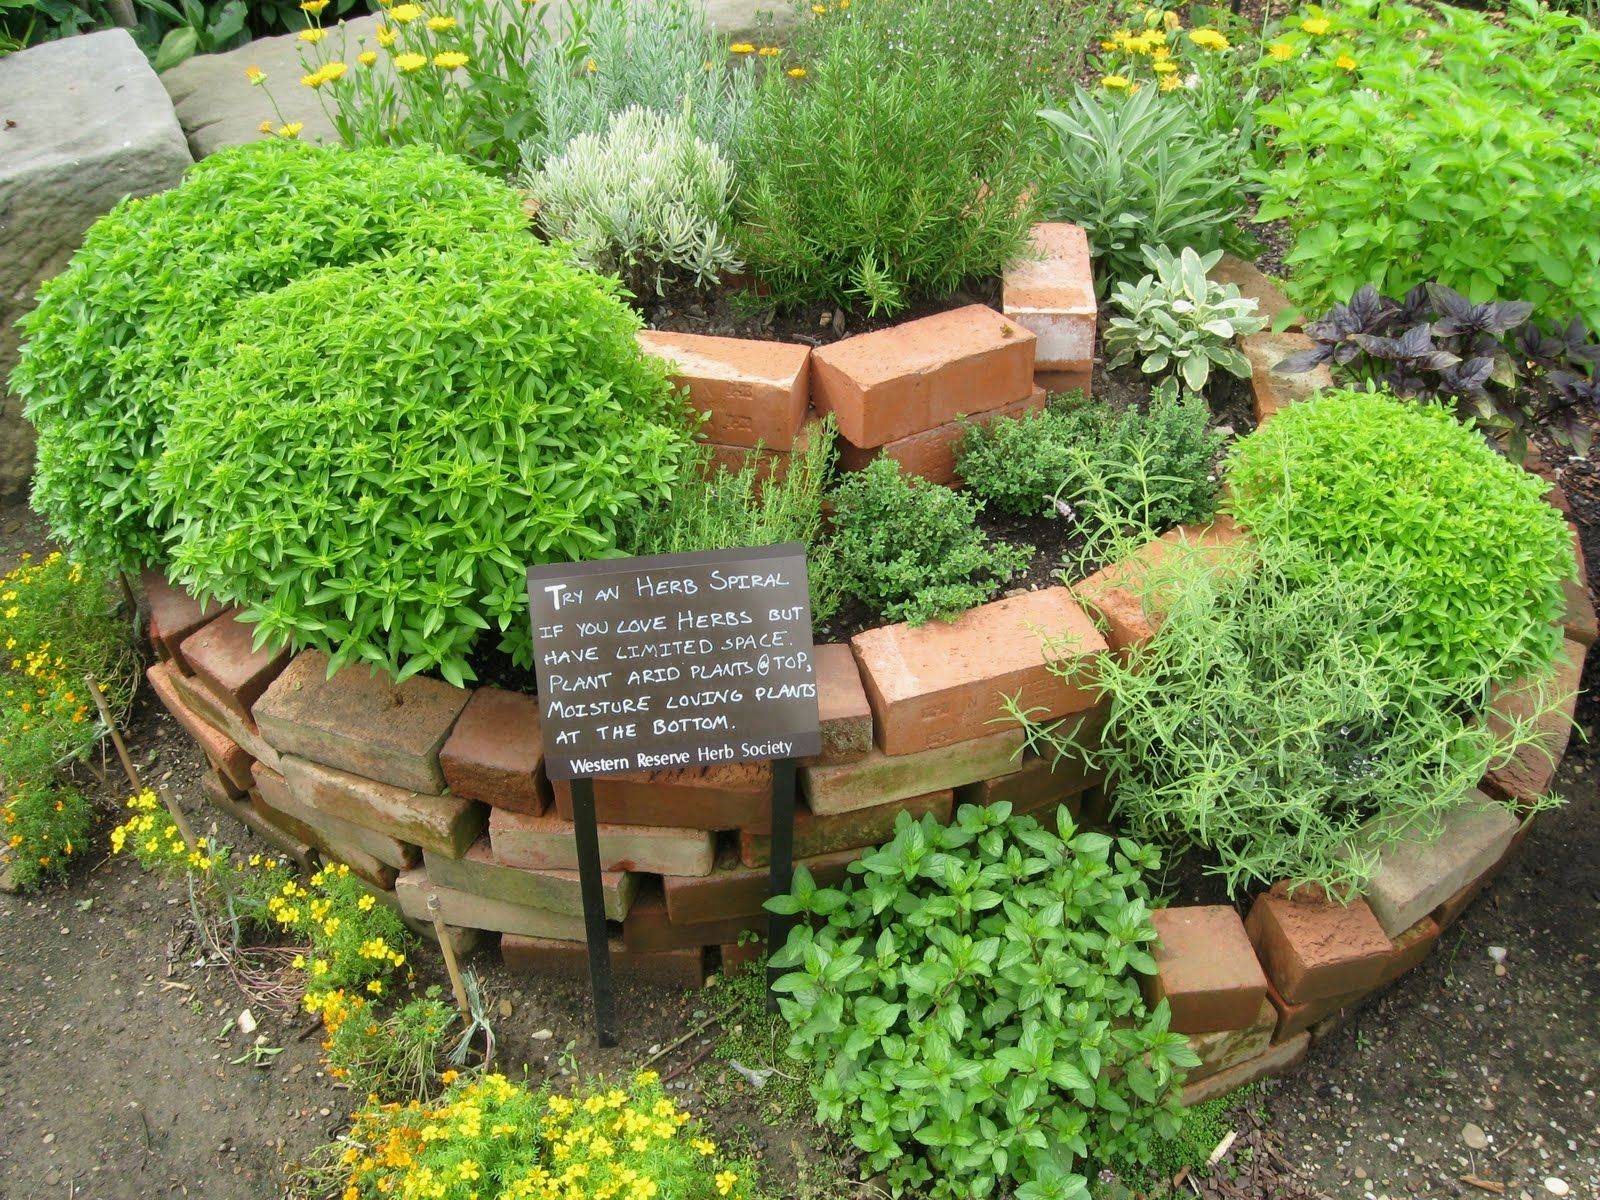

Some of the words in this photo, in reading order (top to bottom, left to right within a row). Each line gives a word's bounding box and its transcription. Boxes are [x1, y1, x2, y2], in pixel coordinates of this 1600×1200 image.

[595, 586, 619, 600] AN
[637, 577, 697, 597] HERB
[710, 571, 789, 590] SPIRAL
[539, 624, 564, 638] IF
[577, 621, 609, 636] YOU
[617, 616, 666, 633] LOVE
[678, 611, 752, 630] HERBS
[769, 607, 803, 621] BUT
[544, 648, 599, 666] HAVE
[616, 639, 712, 660] LIMITED
[721, 631, 793, 651] SPACE.
[549, 672, 612, 693] PLANT
[628, 667, 680, 685] ARID
[691, 662, 753, 678] PLANTS
[547, 696, 651, 719] MOISTURE
[666, 690, 743, 708] LOVING
[755, 684, 816, 701] PLANTS
[555, 731, 580, 744] AT
[597, 724, 636, 740] THE
[653, 716, 736, 734] BOTTOM.
[570, 754, 629, 774] Western
[638, 750, 690, 767] Reserve
[698, 746, 733, 760] Herb
[741, 740, 793, 758] Society
